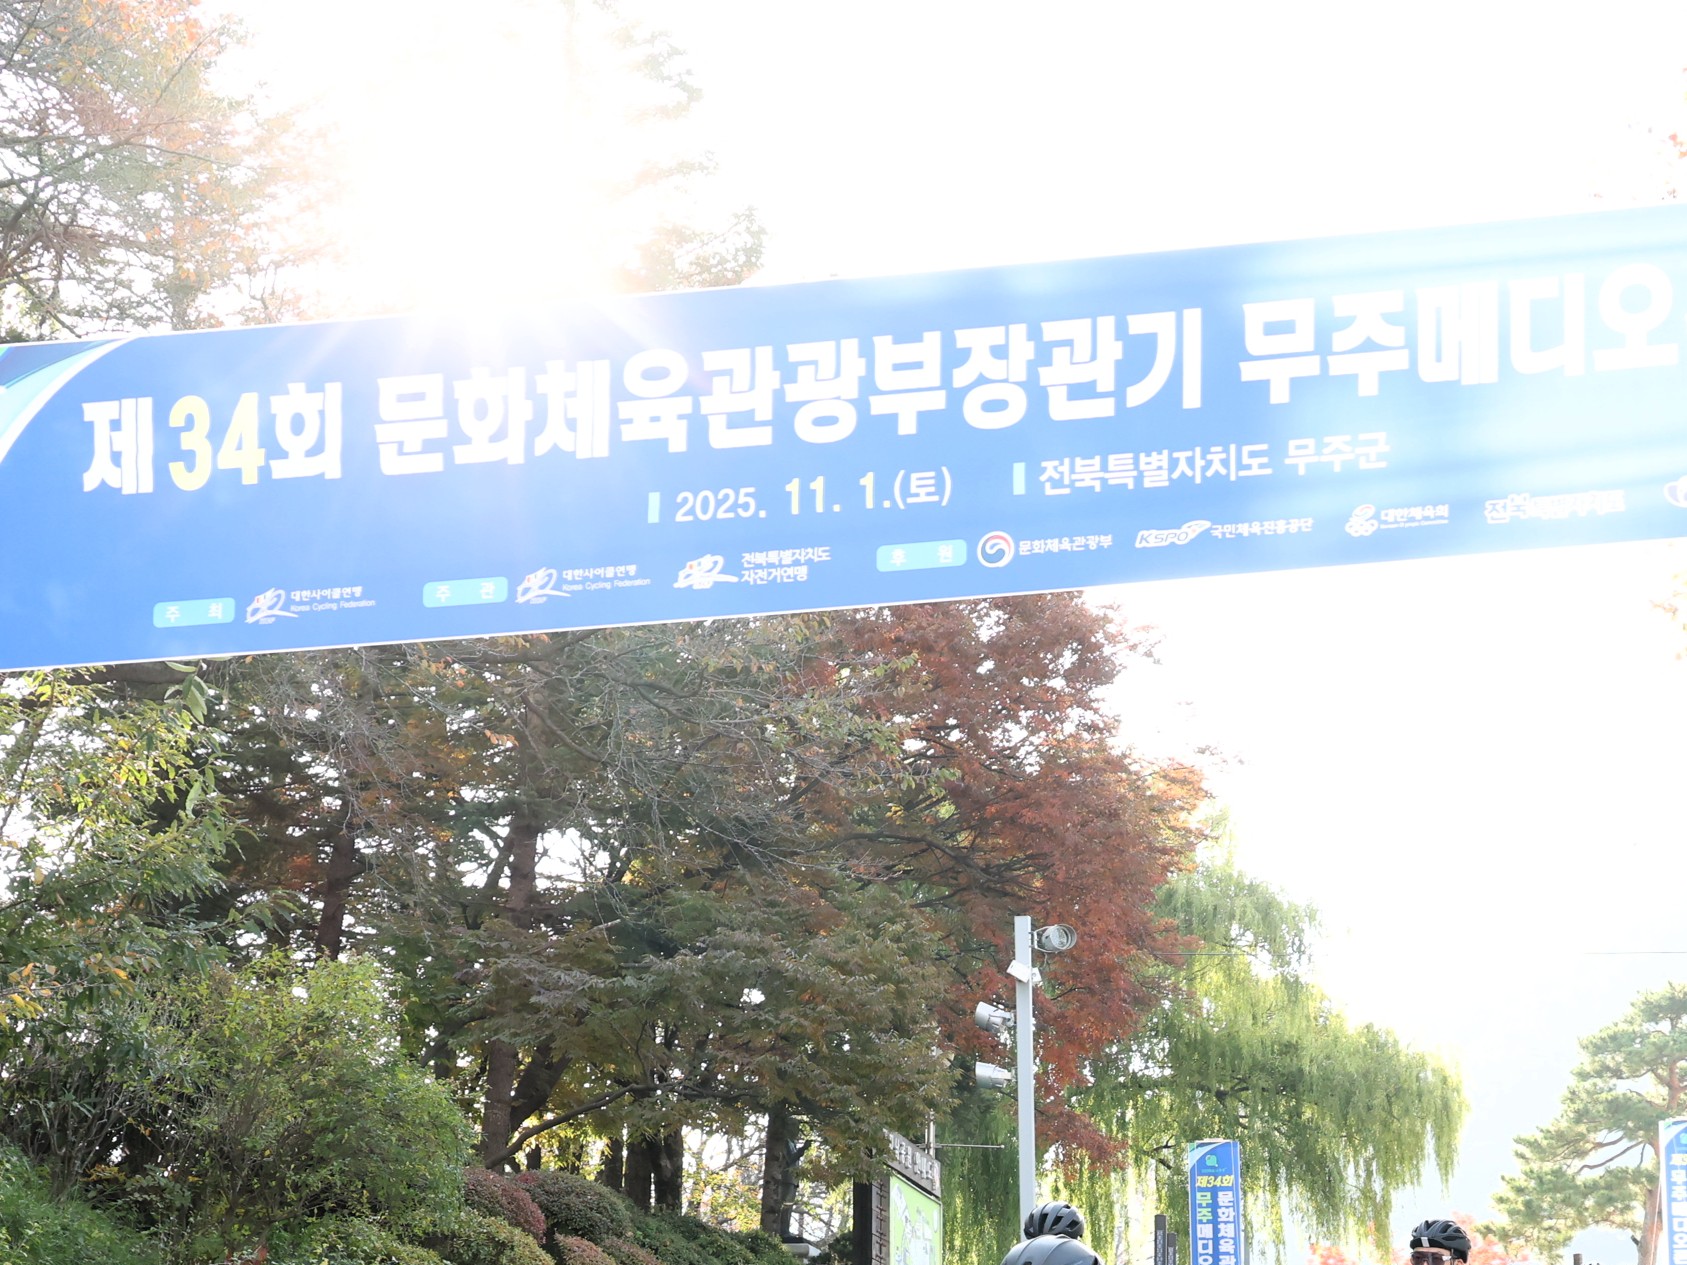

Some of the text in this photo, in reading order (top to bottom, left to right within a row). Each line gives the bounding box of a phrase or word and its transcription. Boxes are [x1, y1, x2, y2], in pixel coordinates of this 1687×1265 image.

[80, 262, 1687, 496] 제34회 문화체육관광부장관기 무주메디오
[1038, 430, 1392, 497] 전북특별자치도 무주군
[674, 486, 767, 523] 2025.
[784, 475, 841, 516] 11.
[1136, 529, 1191, 548] KSPO
[1210, 518, 1314, 539] 국민체육진흥공단
[1018, 534, 1114, 556] 문화체육관광부
[740, 546, 832, 568] 전북특별자치도
[562, 563, 637, 581] 대한사이클연맹
[740, 566, 809, 586] 자전거연맹
[290, 586, 363, 602] 대한사이클연맹
[585, 580, 612, 591] Cycling
[613, 577, 652, 589] Federation
[312, 601, 338, 612] Cycling
[339, 598, 376, 610] Federation
[1195, 1175, 1235, 1187] 제34회
